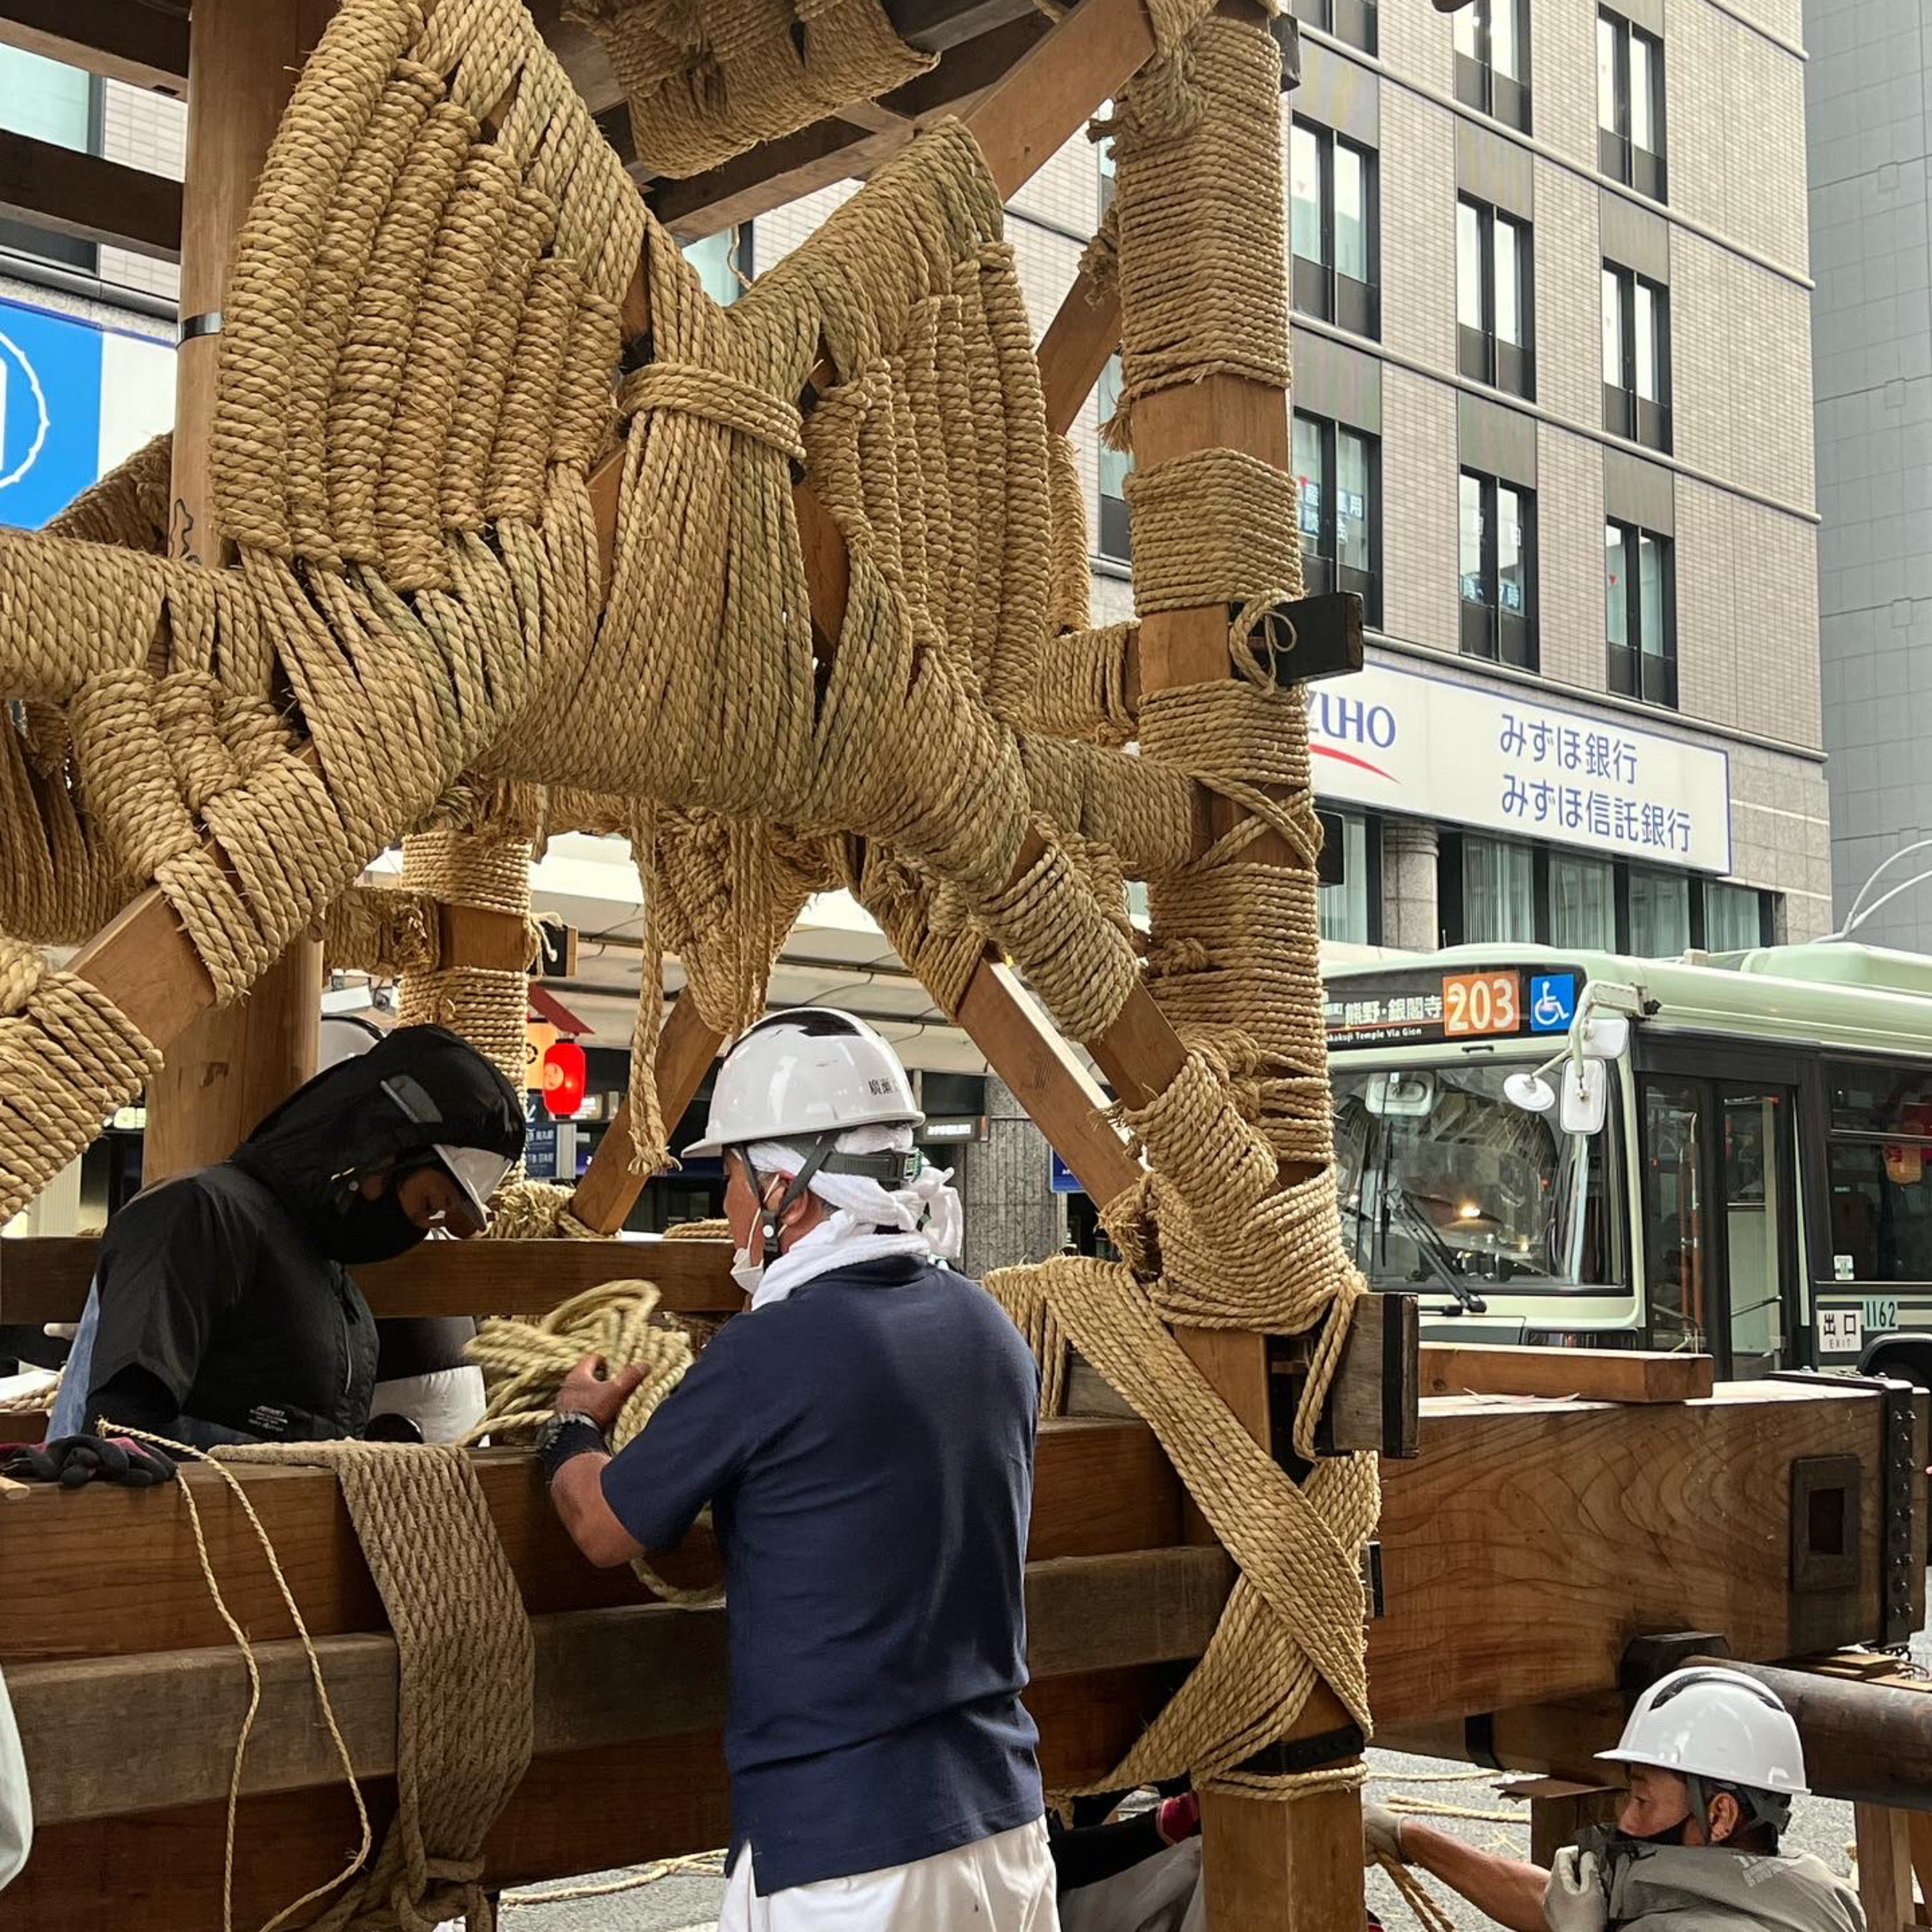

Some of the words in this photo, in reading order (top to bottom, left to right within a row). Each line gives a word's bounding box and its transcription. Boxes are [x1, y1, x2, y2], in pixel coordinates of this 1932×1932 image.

[1501, 714, 1638, 784] みずほ銀行
[1502, 774, 1691, 853] みずほ信託銀行
[1448, 978, 1514, 1031] 203
[1356, 1030, 1385, 1040] Temple
[1387, 1029, 1400, 1037] Via
[1402, 1028, 1422, 1036] Gion
[1824, 1313, 1856, 1336] 出口
[1866, 1300, 1897, 1327] 1162
